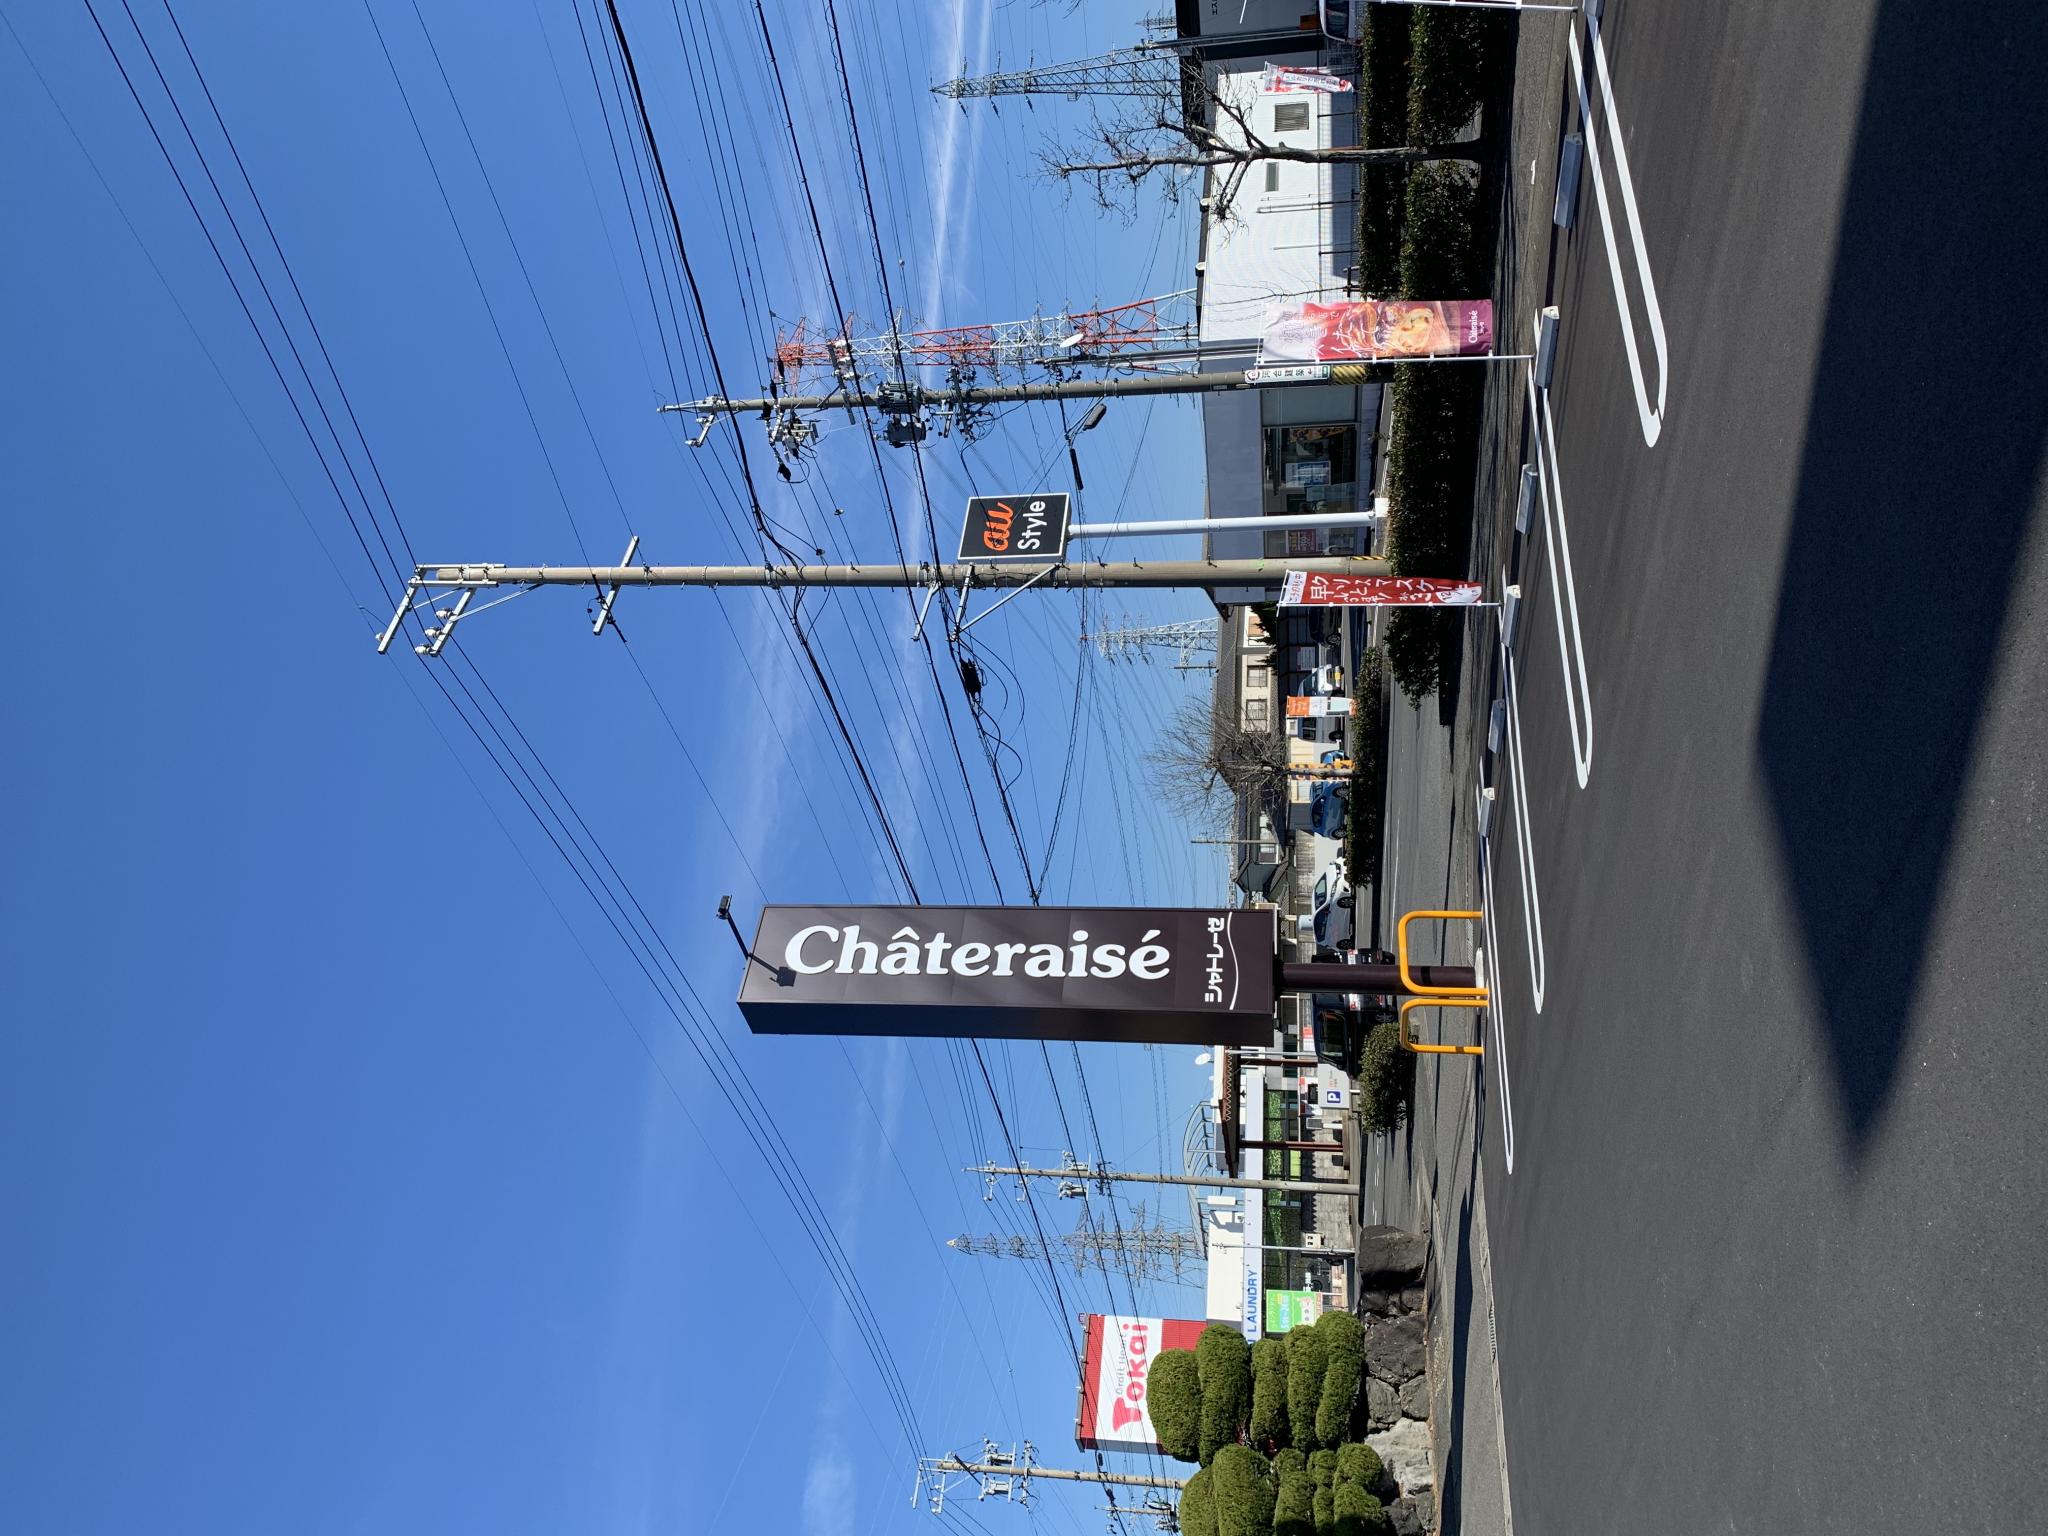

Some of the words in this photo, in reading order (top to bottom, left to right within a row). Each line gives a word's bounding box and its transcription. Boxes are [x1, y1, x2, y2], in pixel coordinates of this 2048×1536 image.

[983, 501, 1014, 552] au
[1016, 500, 1048, 550] Style
[784, 925, 1170, 980] Châteraisé
[1204, 917, 1225, 1003] シャトレーゼ
[1247, 1269, 1257, 1333] LAUNDRY
[1112, 1323, 1148, 1432] Tokai
